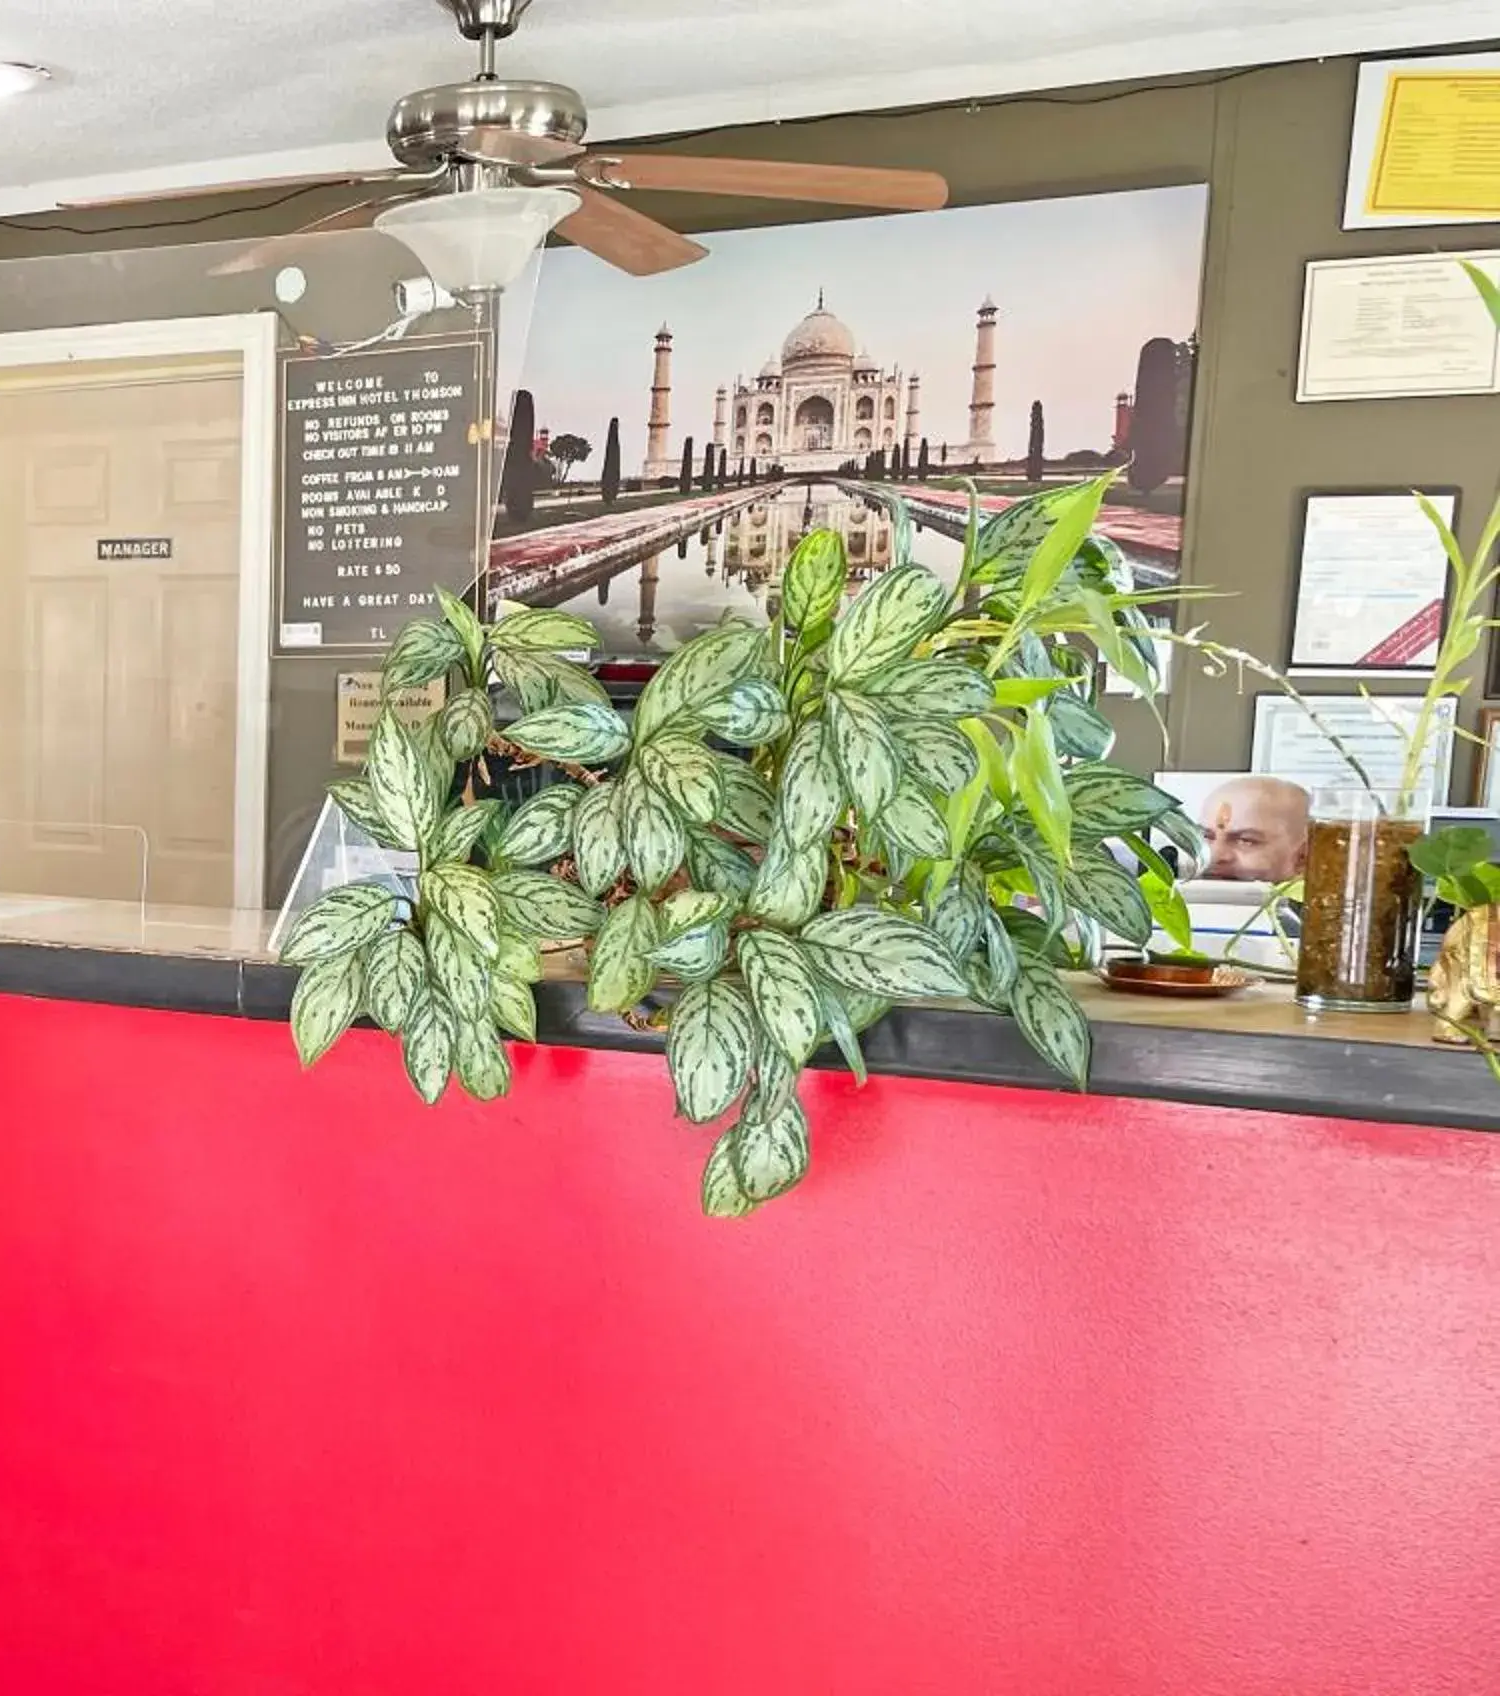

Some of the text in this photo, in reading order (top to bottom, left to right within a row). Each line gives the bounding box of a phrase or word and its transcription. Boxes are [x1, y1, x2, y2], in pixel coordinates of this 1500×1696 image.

[315, 371, 440, 393] WELCOME TO
[287, 397, 336, 411] EXPRESS
[360, 391, 399, 405] HOTEL
[404, 385, 463, 401] THOMSON
[304, 409, 449, 431] NO REFUNDS ON ROOMS
[304, 432, 320, 443] NO
[322, 428, 370, 442] VISITORS
[411, 424, 423, 435] 10
[426, 422, 443, 435] PM
[303, 448, 335, 461] CHECK
[338, 446, 359, 459] OUT
[361, 445, 386, 457] TIME
[405, 443, 413, 454] 11
[416, 441, 434, 454] AM
[301, 472, 339, 485] COFFEE
[345, 470, 374, 483] FROM
[387, 468, 403, 481] AM
[301, 490, 339, 504] ROOMS
[301, 507, 325, 519] NON
[329, 503, 377, 518] SMOKING
[393, 500, 449, 515] HANDICAP
[307, 523, 366, 537] NO PETS
[100, 541, 170, 557] MANAGER
[307, 536, 403, 551] NO LOITERING
[337, 565, 369, 577] RATE
[303, 592, 436, 608] HAVE A GREAT DAY
